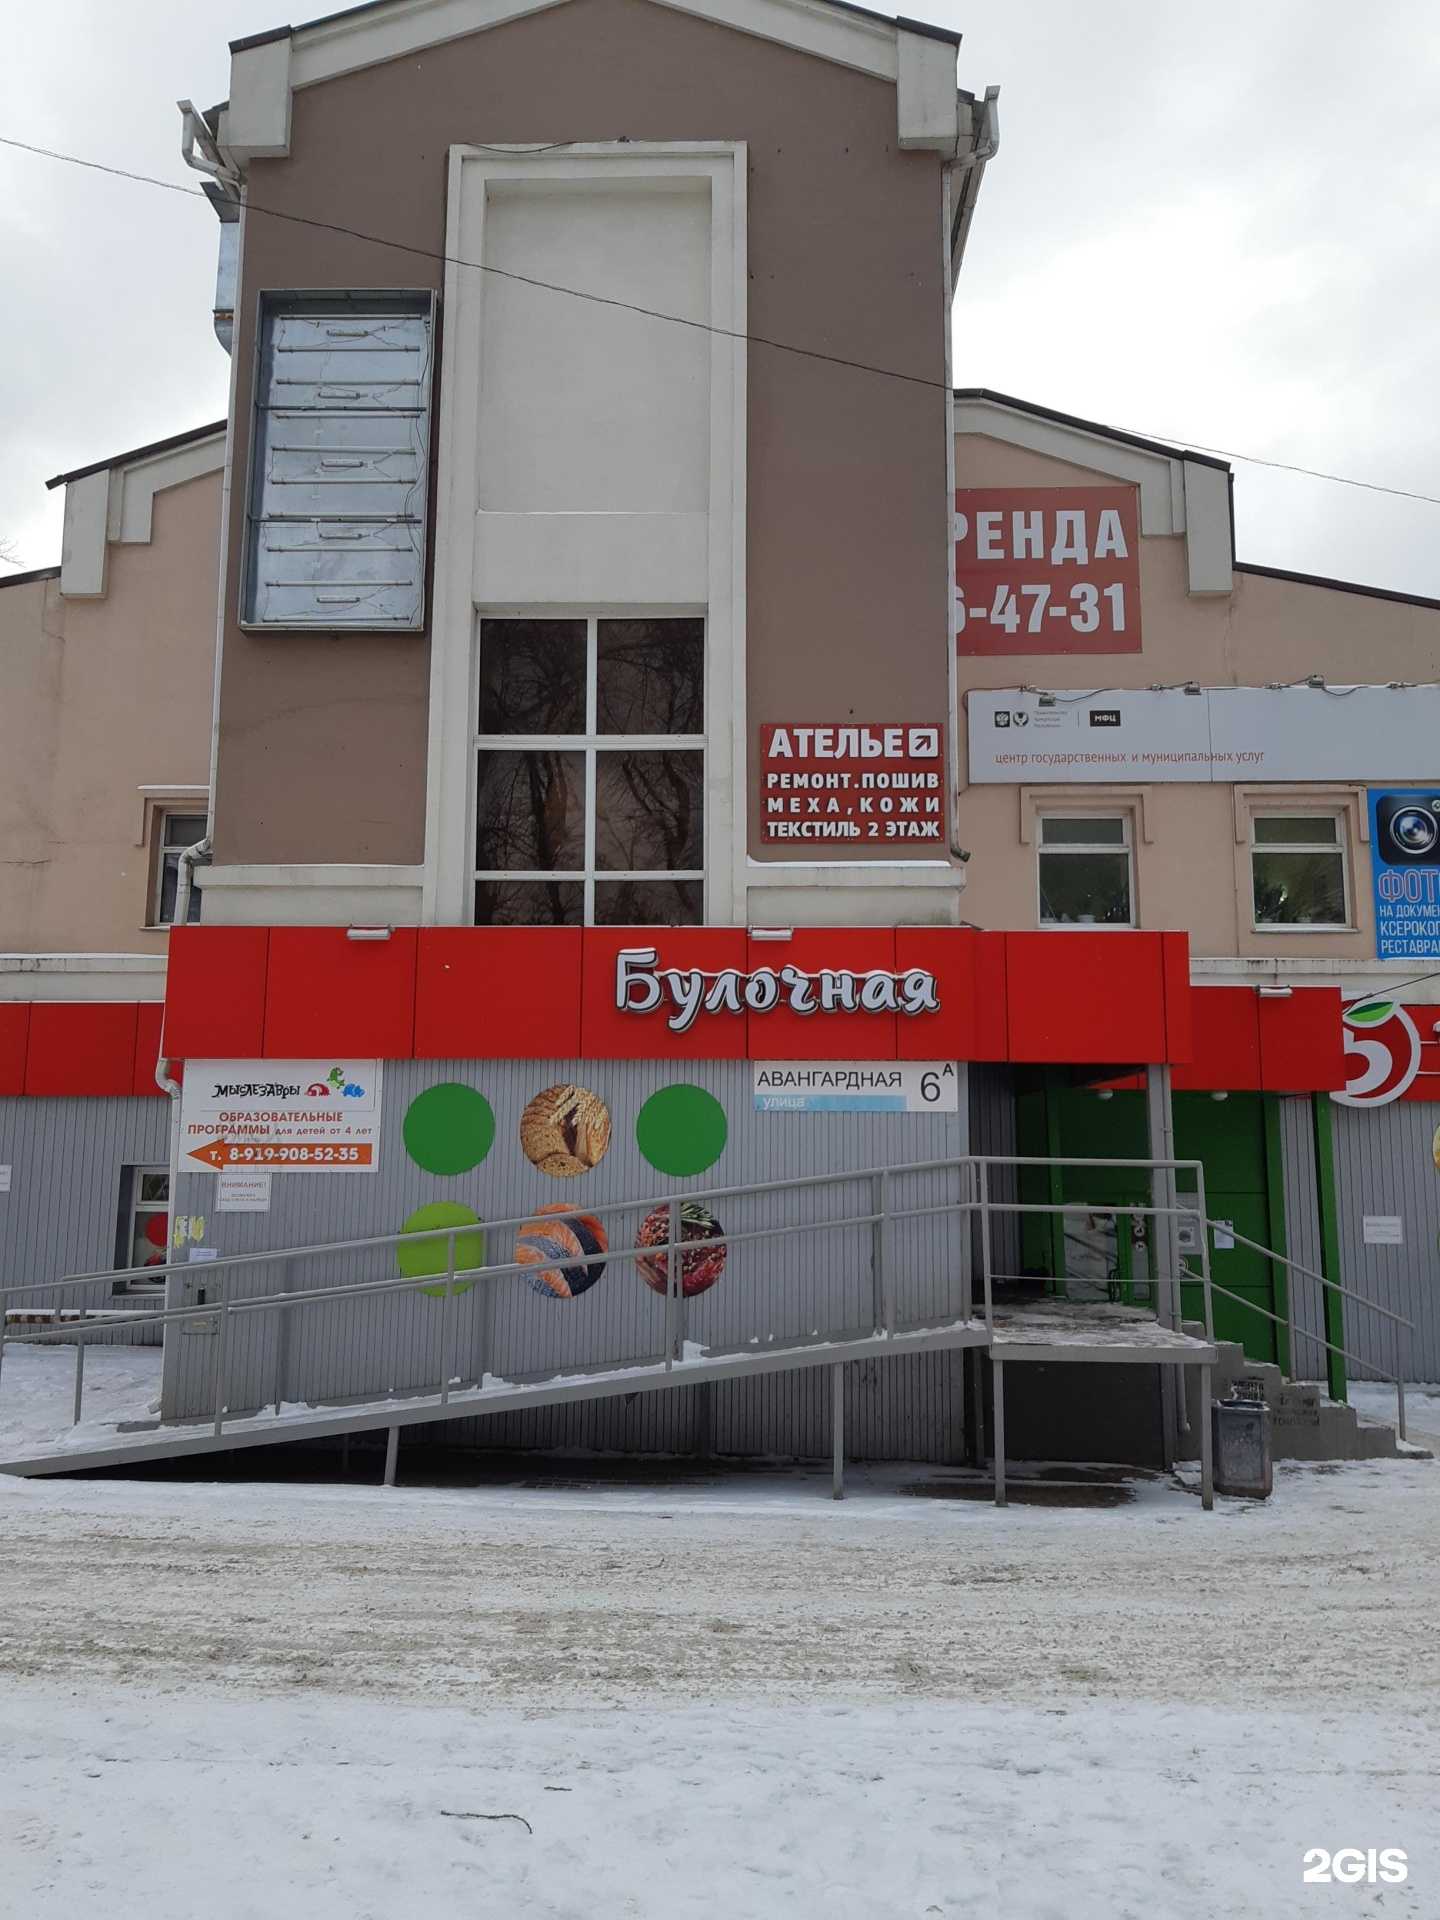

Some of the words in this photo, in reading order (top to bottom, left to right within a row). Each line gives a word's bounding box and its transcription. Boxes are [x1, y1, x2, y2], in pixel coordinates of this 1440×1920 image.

[767, 728, 904, 760] АТЕЛЬЕ
[995, 753, 1028, 766] центр
[1031, 752, 1126, 765] государственных
[1131, 754, 1138, 763] и
[1142, 751, 1233, 764] муниципальных
[1236, 751, 1265, 764] услуг
[767, 821, 861, 837] ТЕКСТИЛЬ
[868, 822, 879, 837] 2
[885, 821, 940, 837] ЭТАЖ
[1378, 868, 1440, 904] ФОТ
[1380, 904, 1394, 918] НА
[615, 946, 942, 1034] Булочная
[757, 1070, 903, 1091] АВАНГАРДНАЯ
[762, 1095, 806, 1111] улица
[219, 1111, 344, 1123] ОБРАЗОВАТЕЛЬНЫЕ
[187, 1124, 270, 1135] ПРОГРАММЫ
[275, 1128, 293, 1136] для
[296, 1127, 325, 1136] детей
[345, 1126, 351, 1135] 4
[229, 1147, 359, 1161] 8-919-908-52-35
